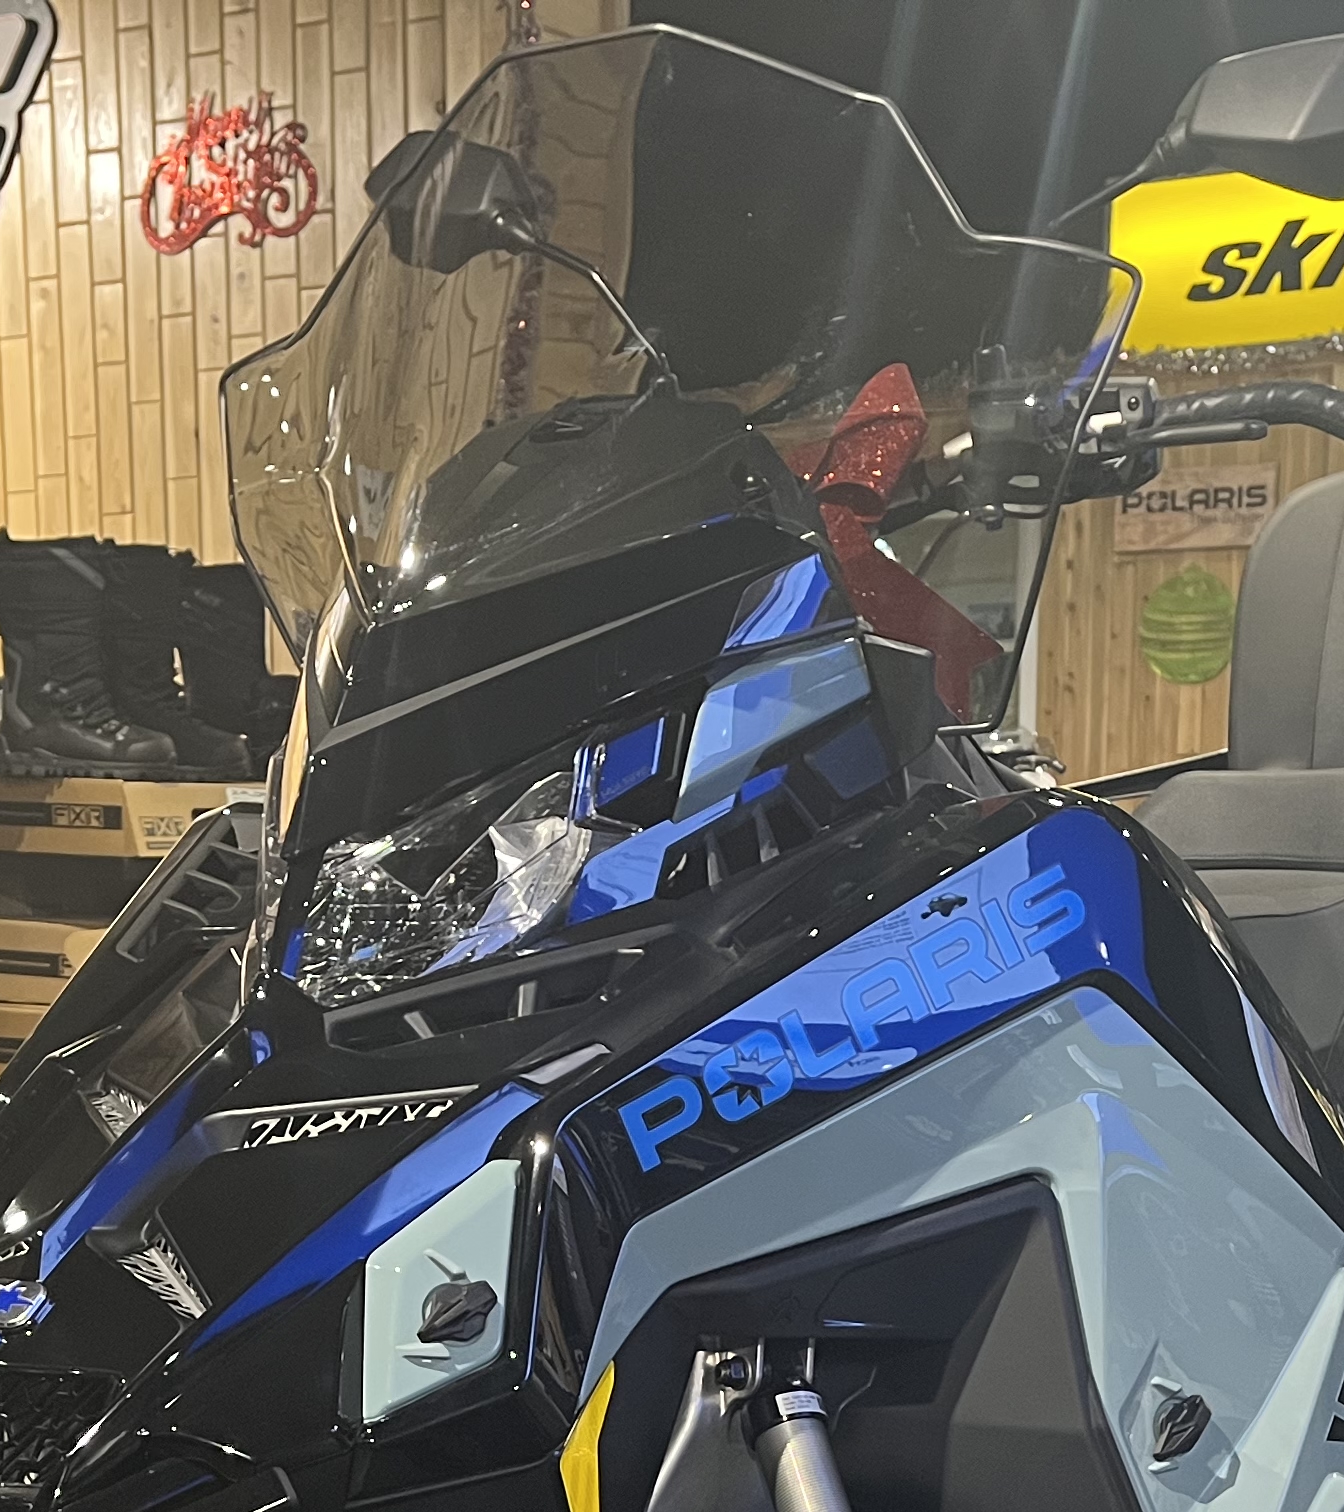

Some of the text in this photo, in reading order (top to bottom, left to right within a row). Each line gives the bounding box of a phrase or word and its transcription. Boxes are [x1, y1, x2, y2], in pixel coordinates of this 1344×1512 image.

[1121, 484, 1268, 515] POLARIS
[51, 805, 104, 827] FXR
[616, 863, 1087, 1174] POLARIS
